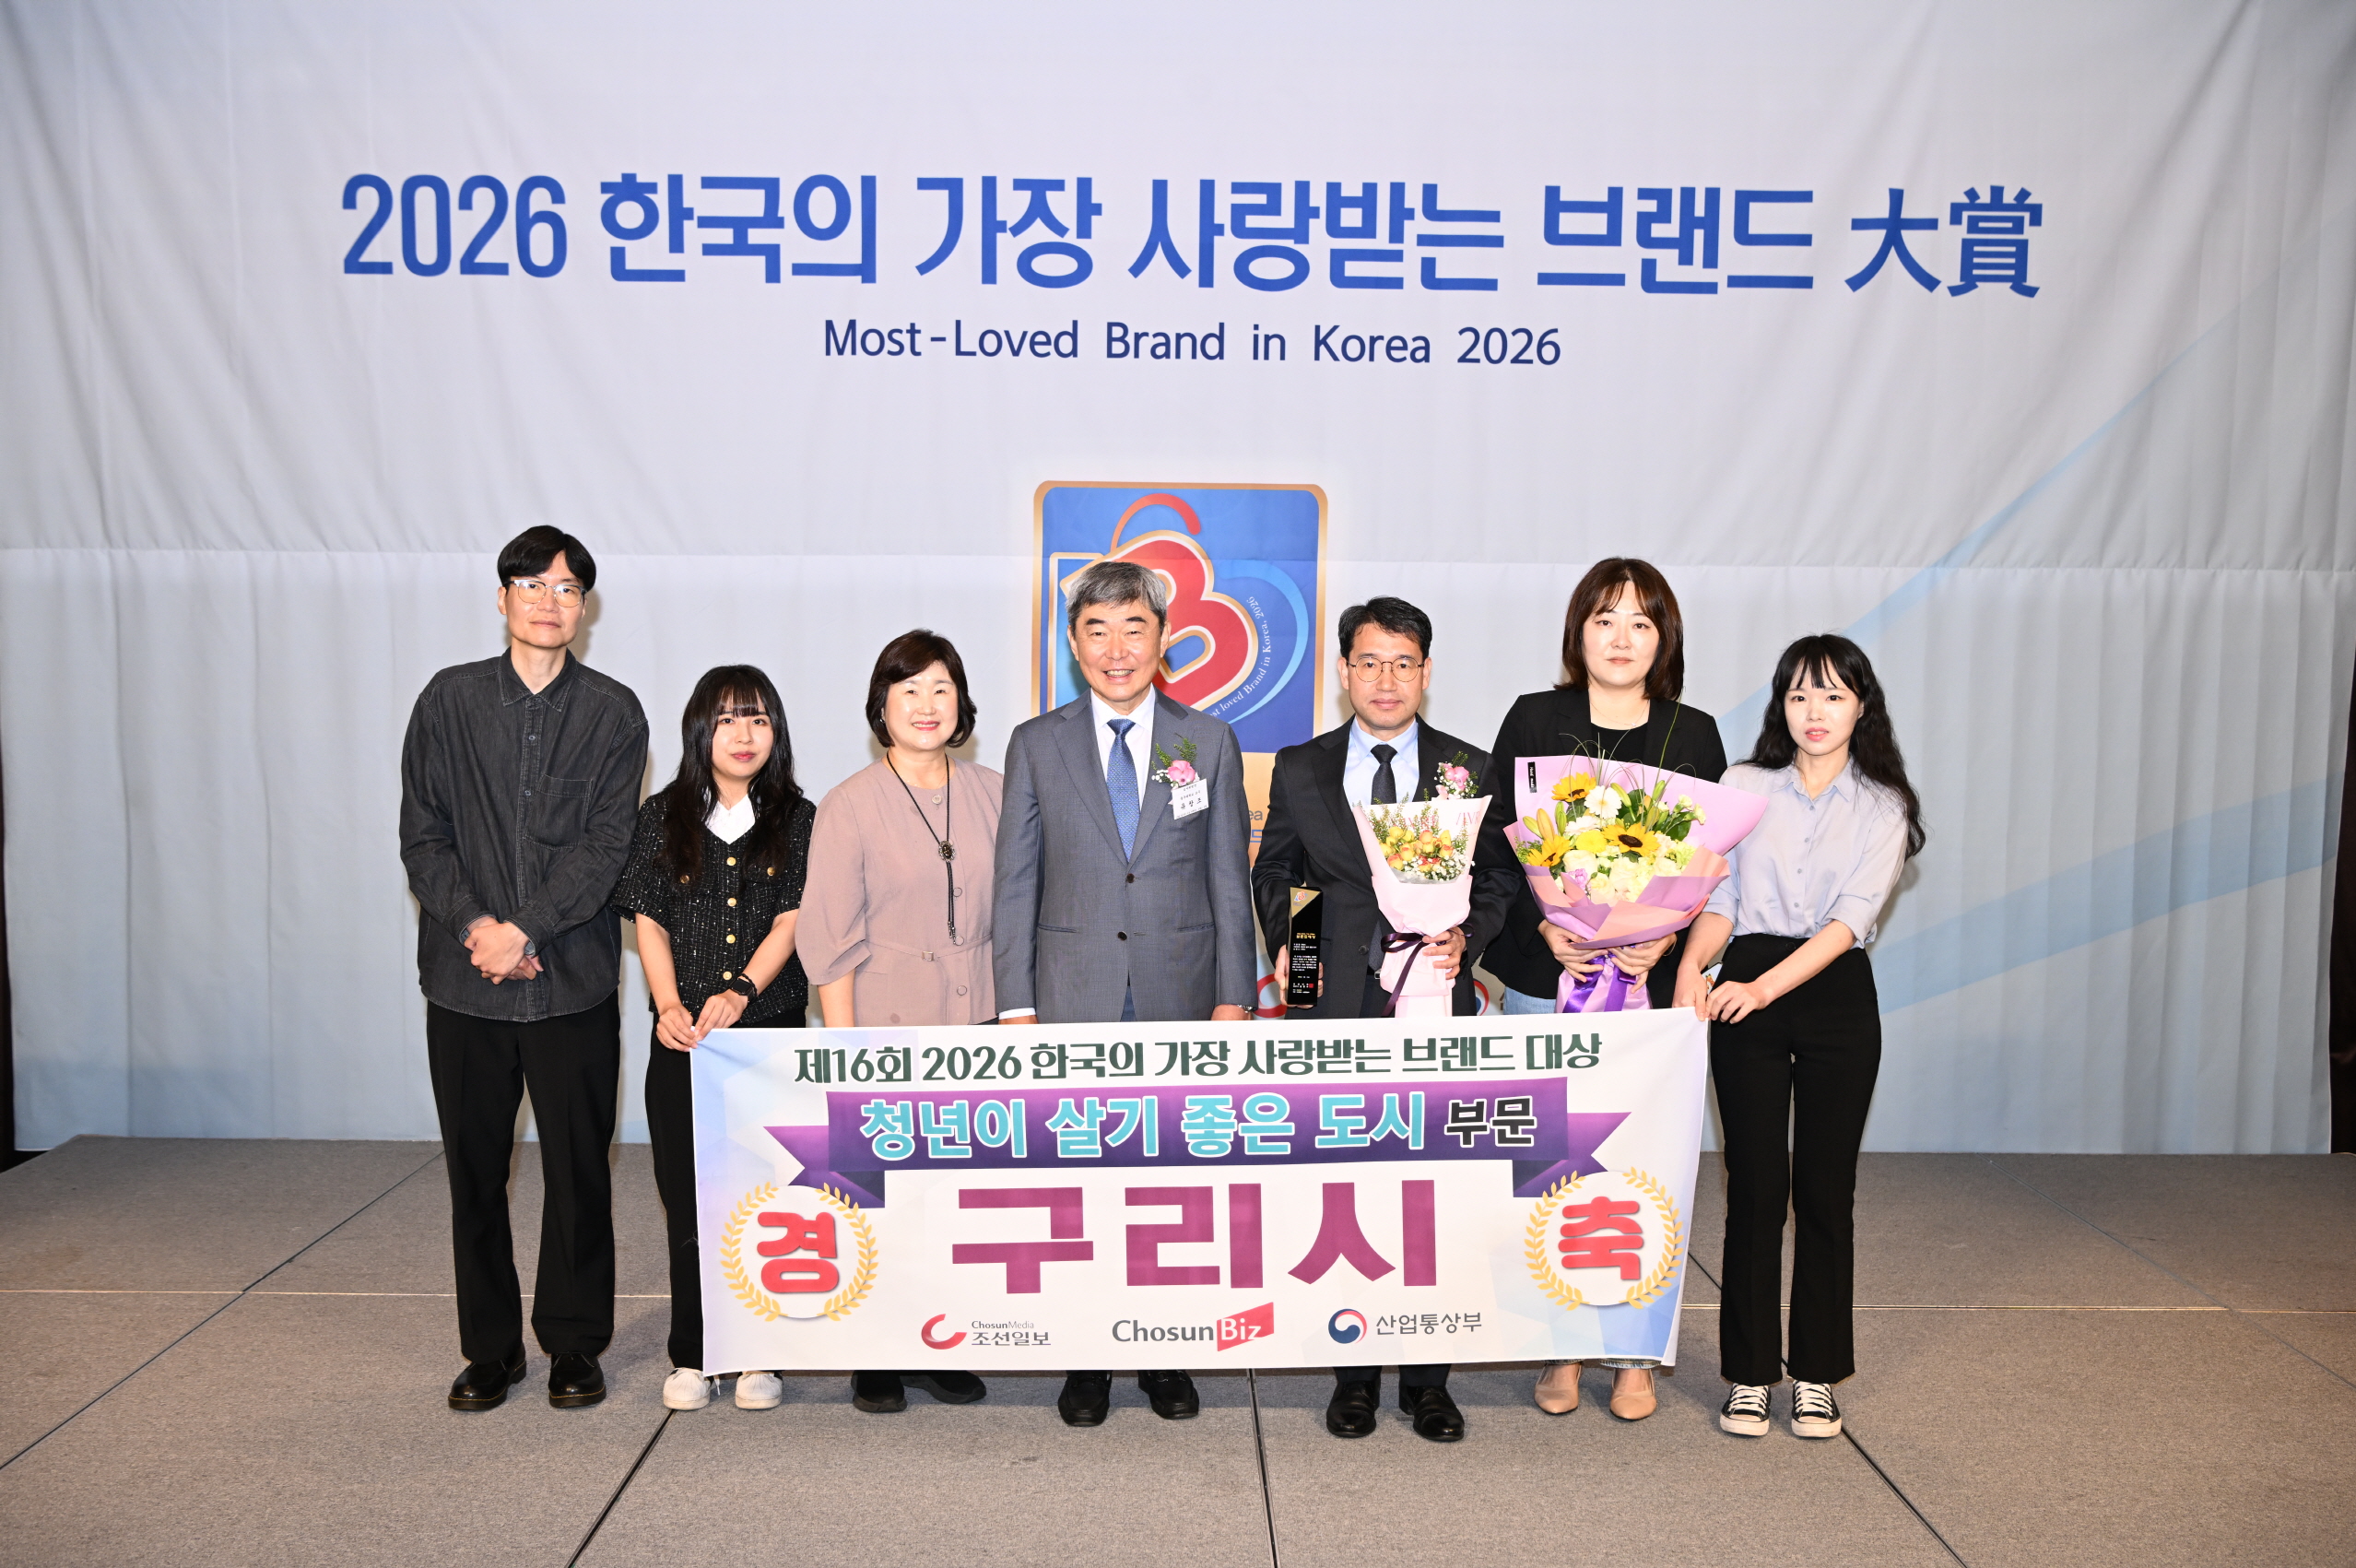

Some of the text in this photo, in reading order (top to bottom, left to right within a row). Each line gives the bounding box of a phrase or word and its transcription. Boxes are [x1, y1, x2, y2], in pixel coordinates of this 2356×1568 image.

[342, 172, 2044, 299] 2026 한국의 가장 사랑받는 브랜드 大賞
[826, 319, 1561, 365] Most-Loved Brand in Korea 2026
[1246, 596, 1264, 619] 2026
[1262, 620, 1271, 653] Korea,
[1260, 656, 1271, 666] in
[1243, 667, 1266, 694] Brand
[1219, 691, 1244, 712] loved
[794, 1032, 1603, 1084] 제16회 2026 한국의 가장 사랑받는 브랜드 대상
[861, 1092, 1536, 1161] 청년이 살기 좋은 도시 부문
[757, 1211, 840, 1294] 경
[951, 1179, 1437, 1295] 구리시
[1558, 1196, 1644, 1280] 축
[971, 1319, 1035, 1330] ChosunMedia
[971, 1330, 1052, 1347] 조선일보
[1375, 1312, 1482, 1336] 산업통상부
